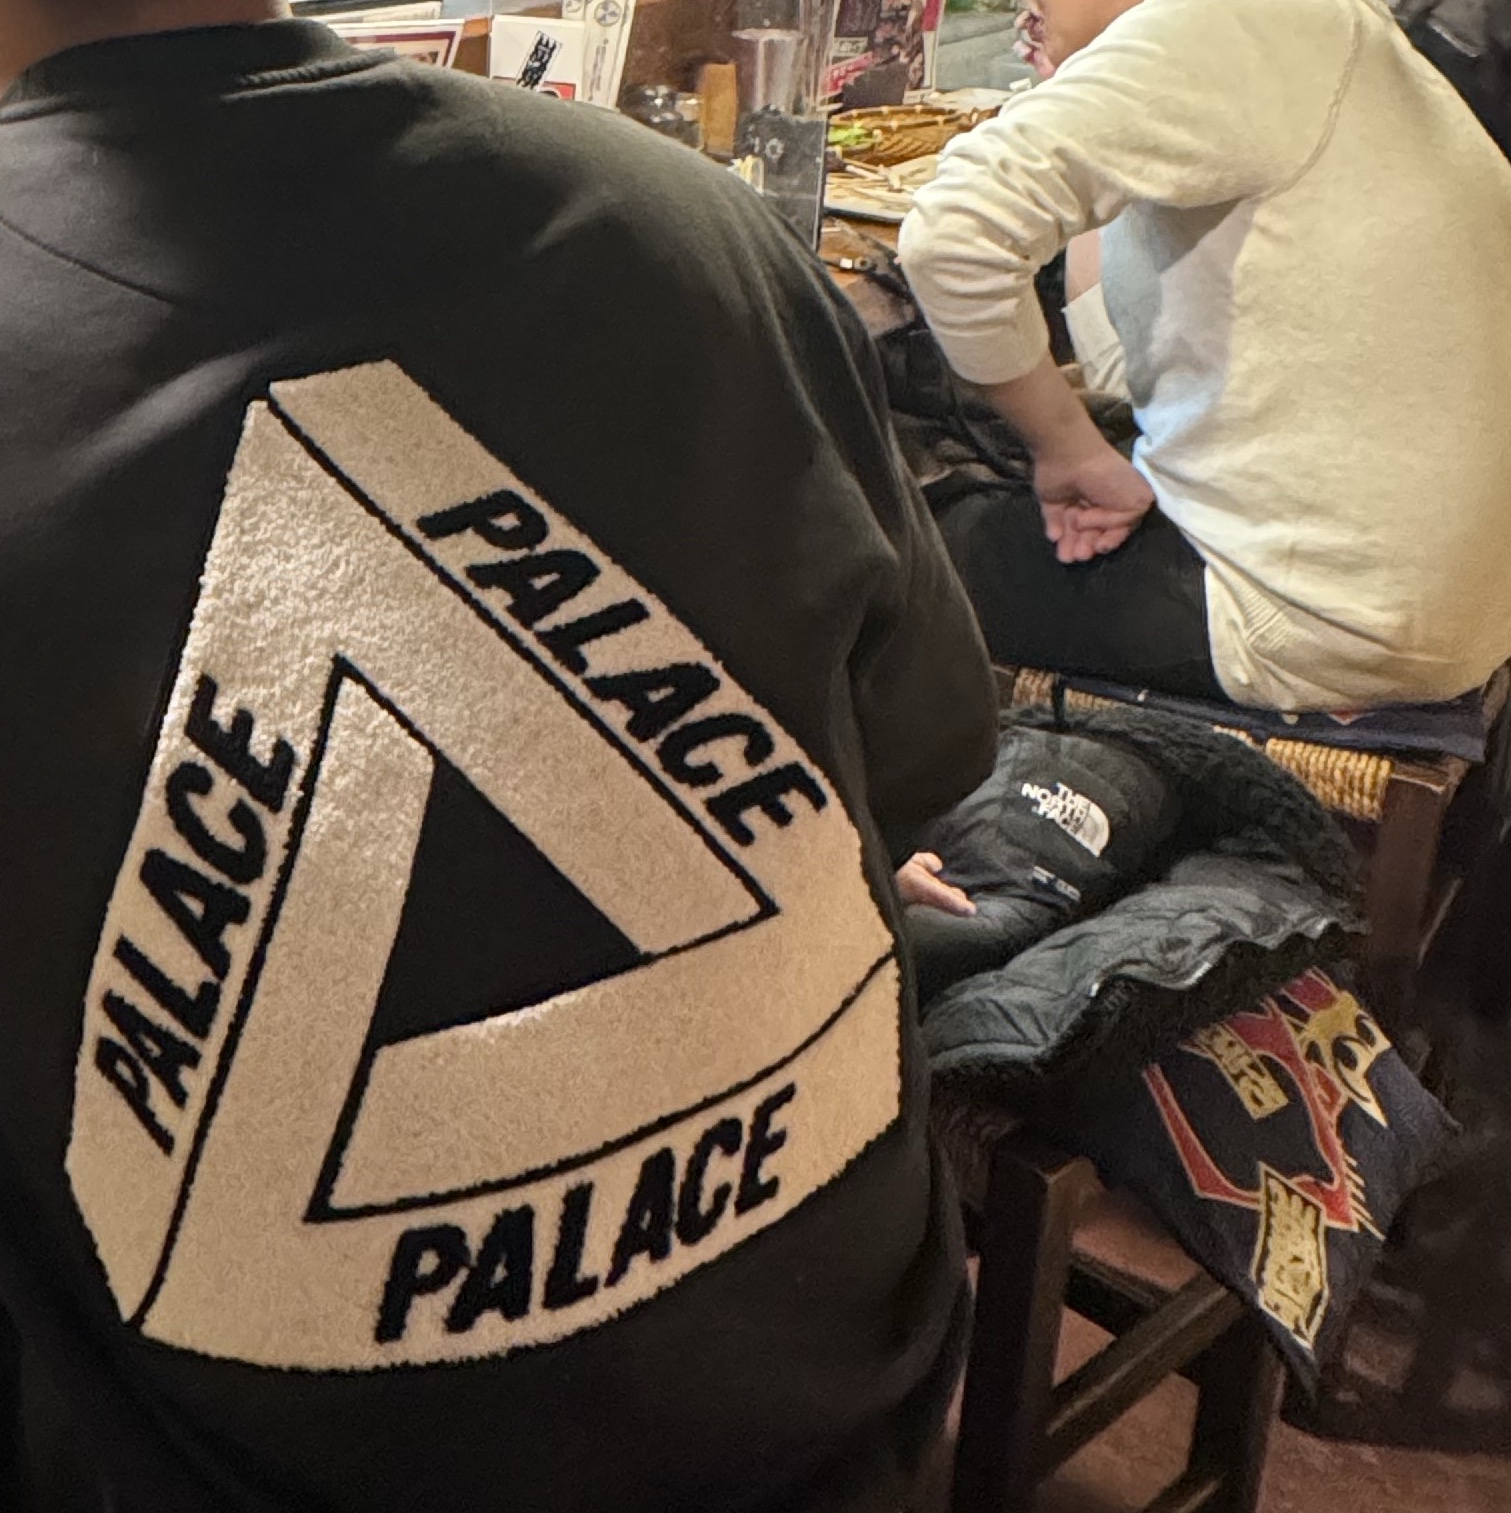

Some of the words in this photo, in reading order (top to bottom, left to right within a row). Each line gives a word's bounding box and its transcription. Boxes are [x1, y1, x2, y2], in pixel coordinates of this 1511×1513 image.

[416, 490, 827, 846] PALACE
[1054, 781, 1092, 820] THE
[95, 674, 297, 1156] PALACE
[373, 1082, 798, 1343] PALACE
